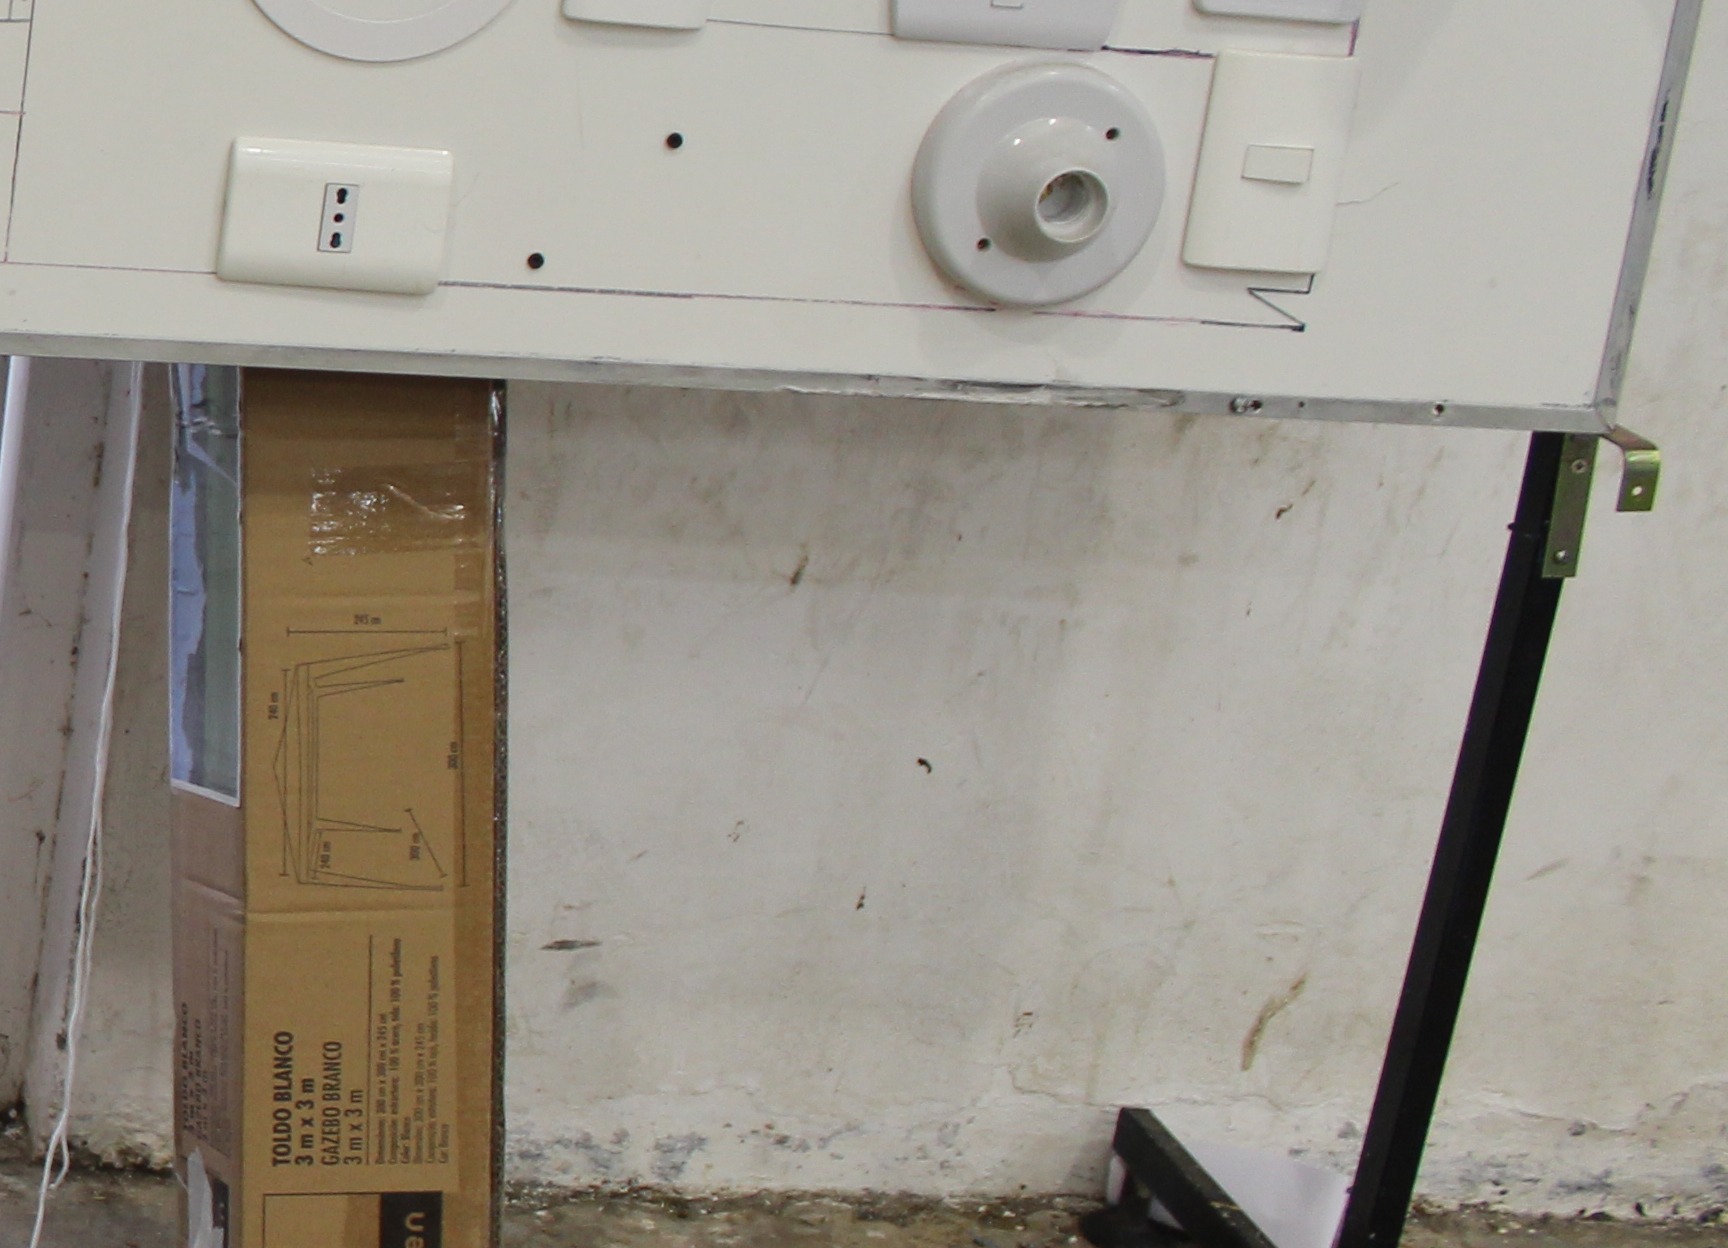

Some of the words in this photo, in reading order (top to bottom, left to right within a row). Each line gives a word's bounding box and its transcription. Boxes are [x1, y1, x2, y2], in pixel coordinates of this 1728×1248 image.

[272, 1031, 294, 1102] BLANCO
[321, 1041, 343, 1102] BRANCO
[301, 1078, 315, 1093] m
[349, 1090, 364, 1104] m
[294, 1099, 315, 1110] 3
[343, 1109, 363, 1118] 3
[300, 1117, 315, 1128] x
[349, 1123, 363, 1132] x
[272, 1108, 292, 1167] TOLDO
[300, 1134, 315, 1149] m
[321, 1107, 341, 1166] GAZEBO
[348, 1137, 363, 1151] m
[294, 1155, 315, 1166] 3
[343, 1156, 363, 1165] 3
